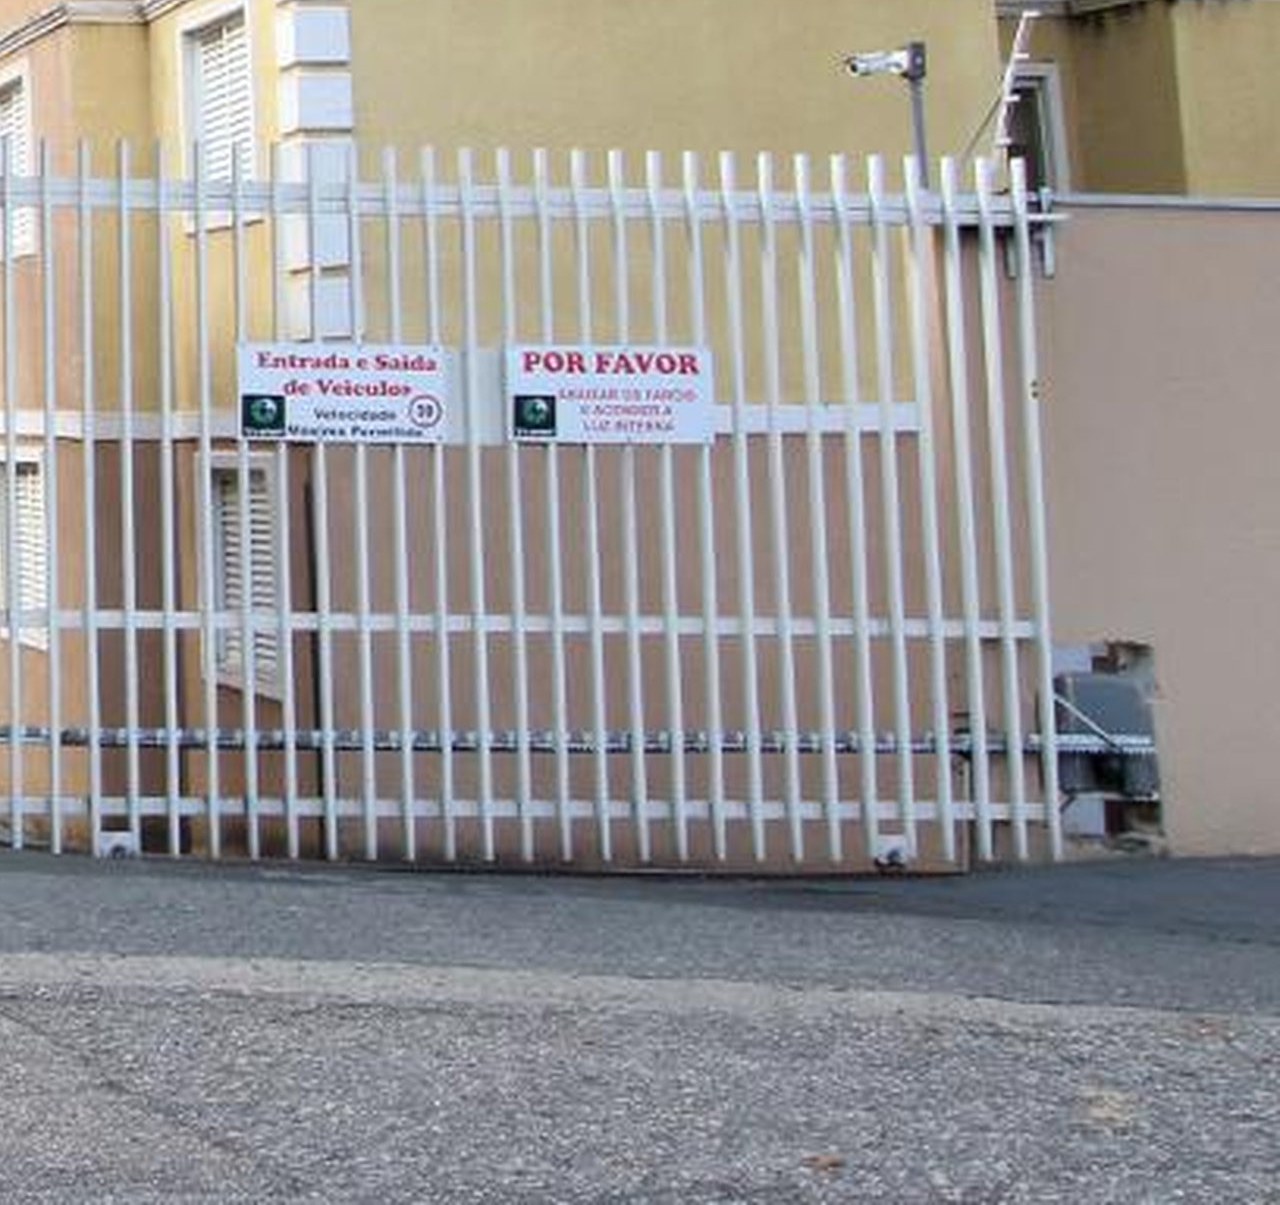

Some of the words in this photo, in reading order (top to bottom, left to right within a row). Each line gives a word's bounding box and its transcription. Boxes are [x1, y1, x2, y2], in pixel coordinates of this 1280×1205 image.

[257, 352, 350, 369] Entrada
[356, 357, 368, 370] e
[522, 351, 587, 373] POR
[595, 352, 700, 374] FAVOR
[283, 380, 311, 395] de
